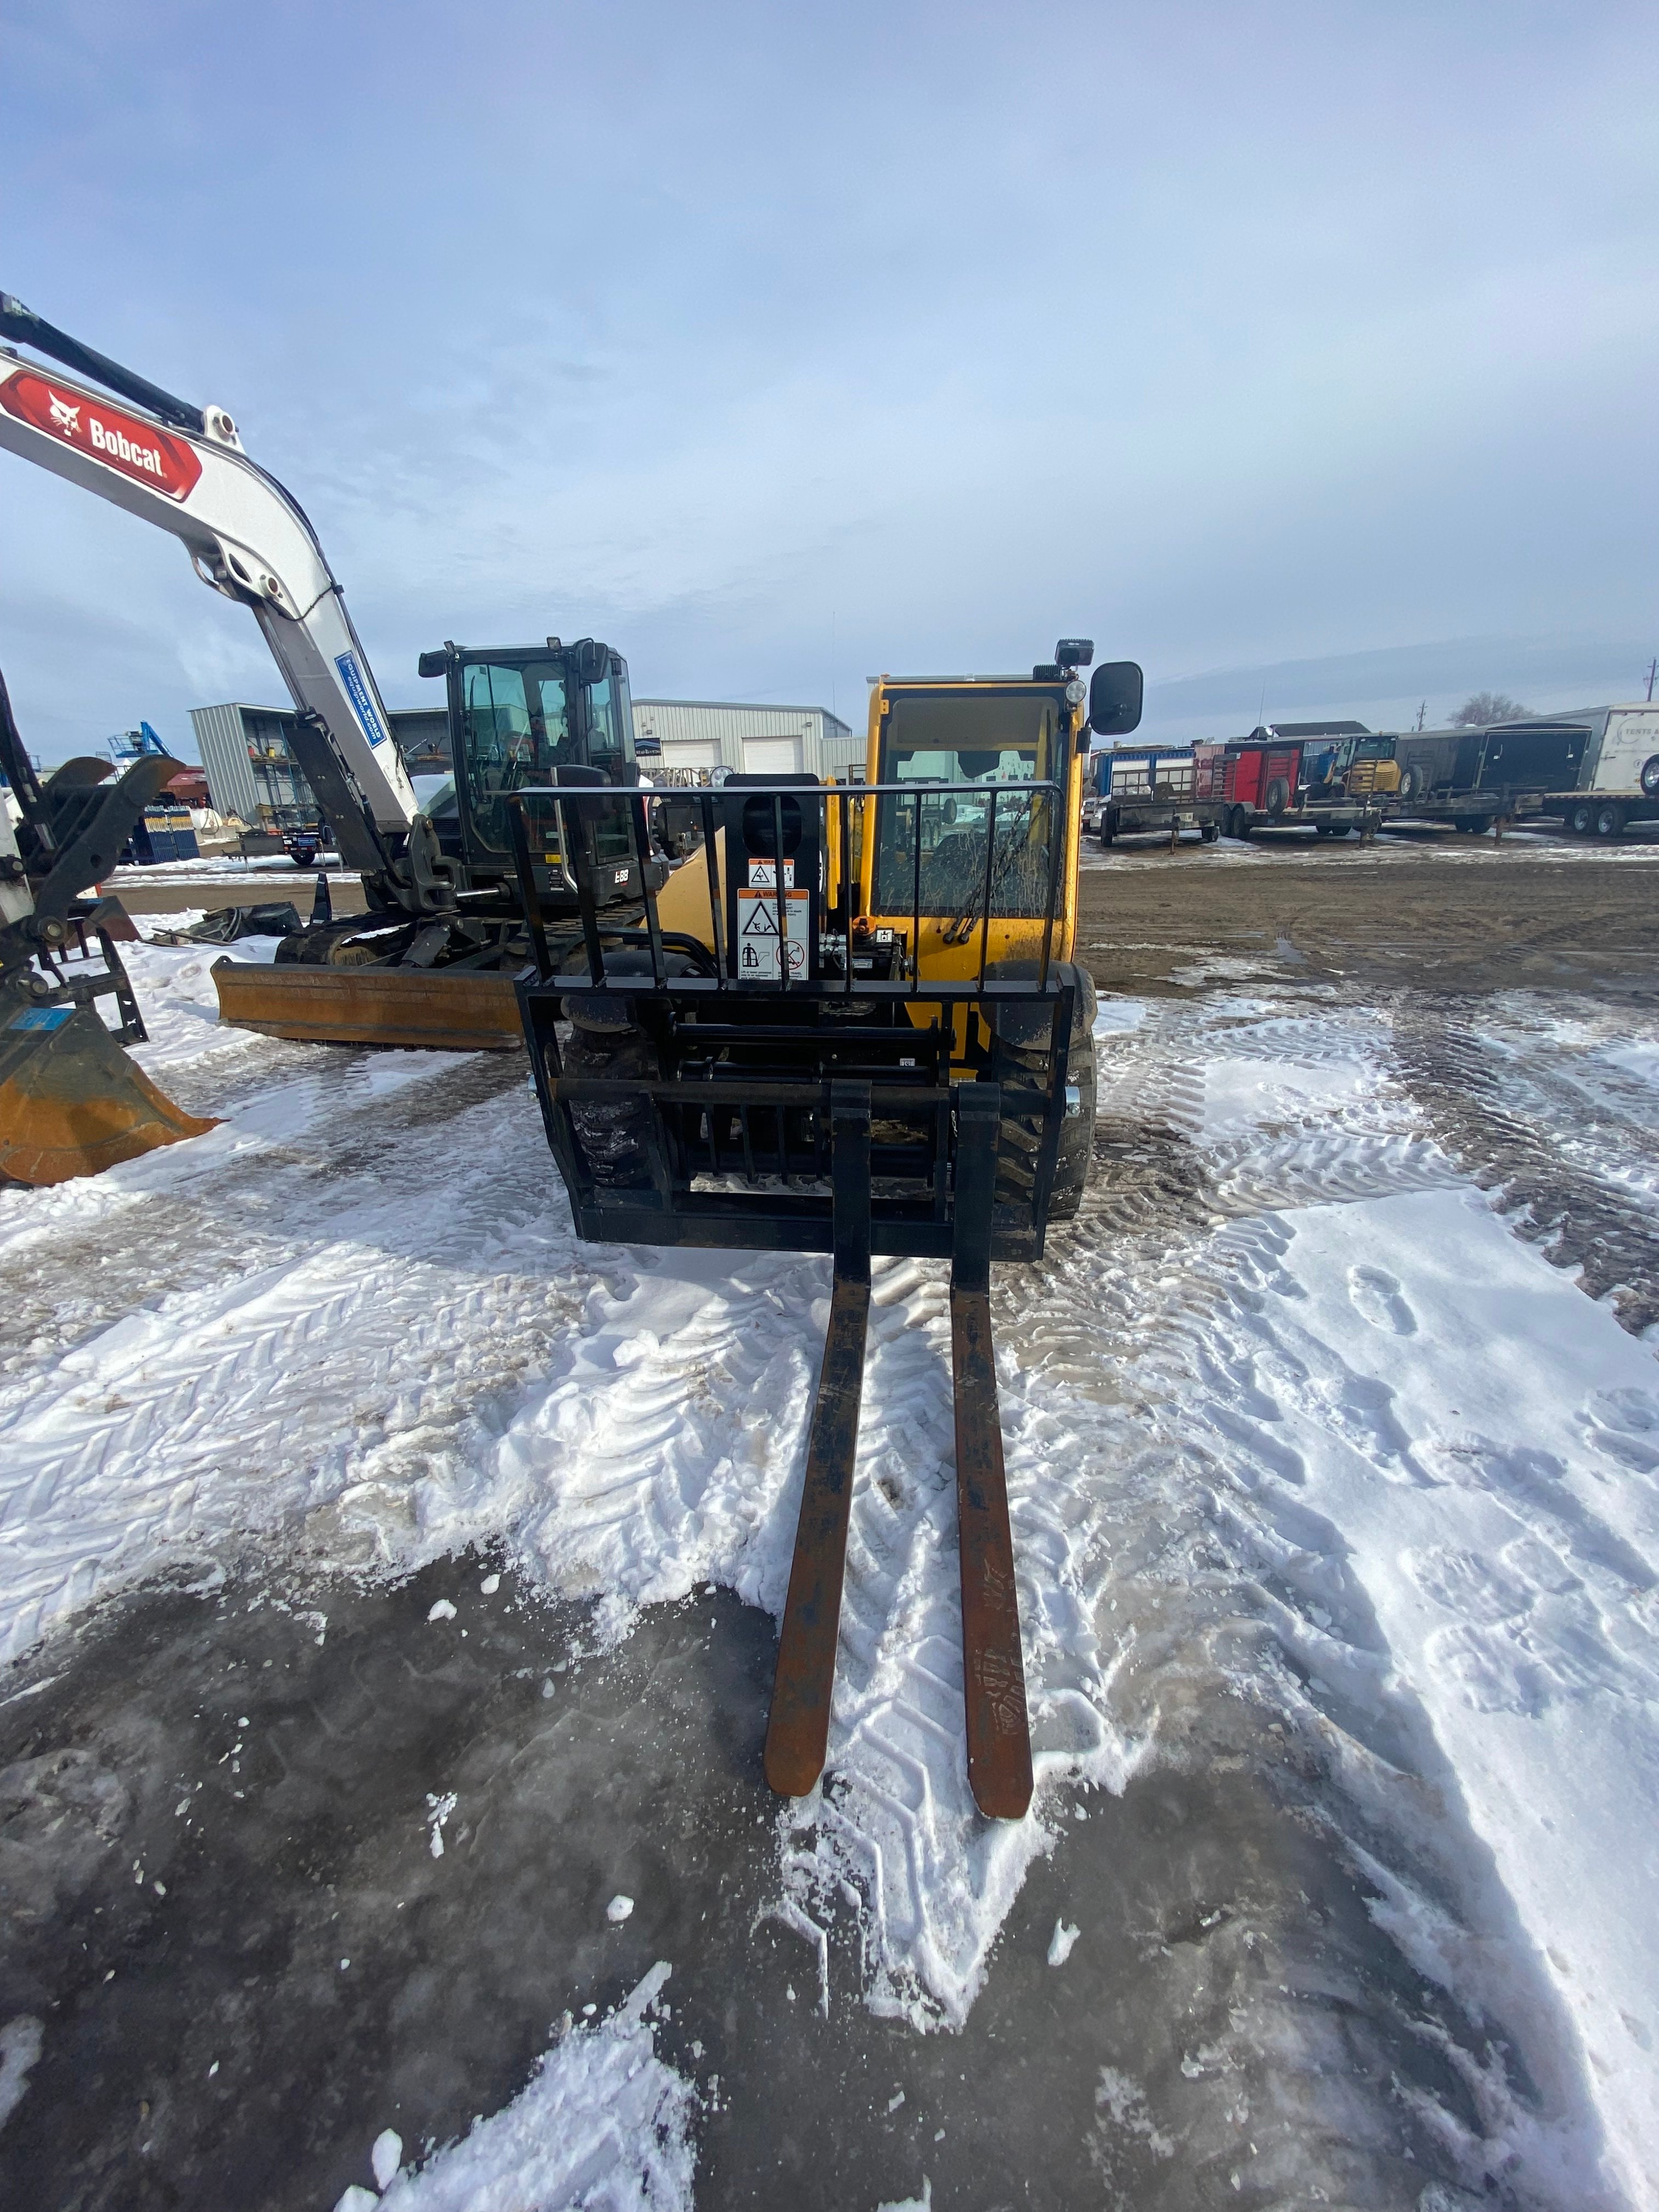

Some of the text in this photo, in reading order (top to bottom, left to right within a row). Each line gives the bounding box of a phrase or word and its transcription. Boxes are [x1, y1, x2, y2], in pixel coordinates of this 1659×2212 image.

[89, 417, 163, 477] Bobcat
[346, 659, 381, 738] EQUIPMENT WORLD
[347, 676, 376, 740] equipworld.com
